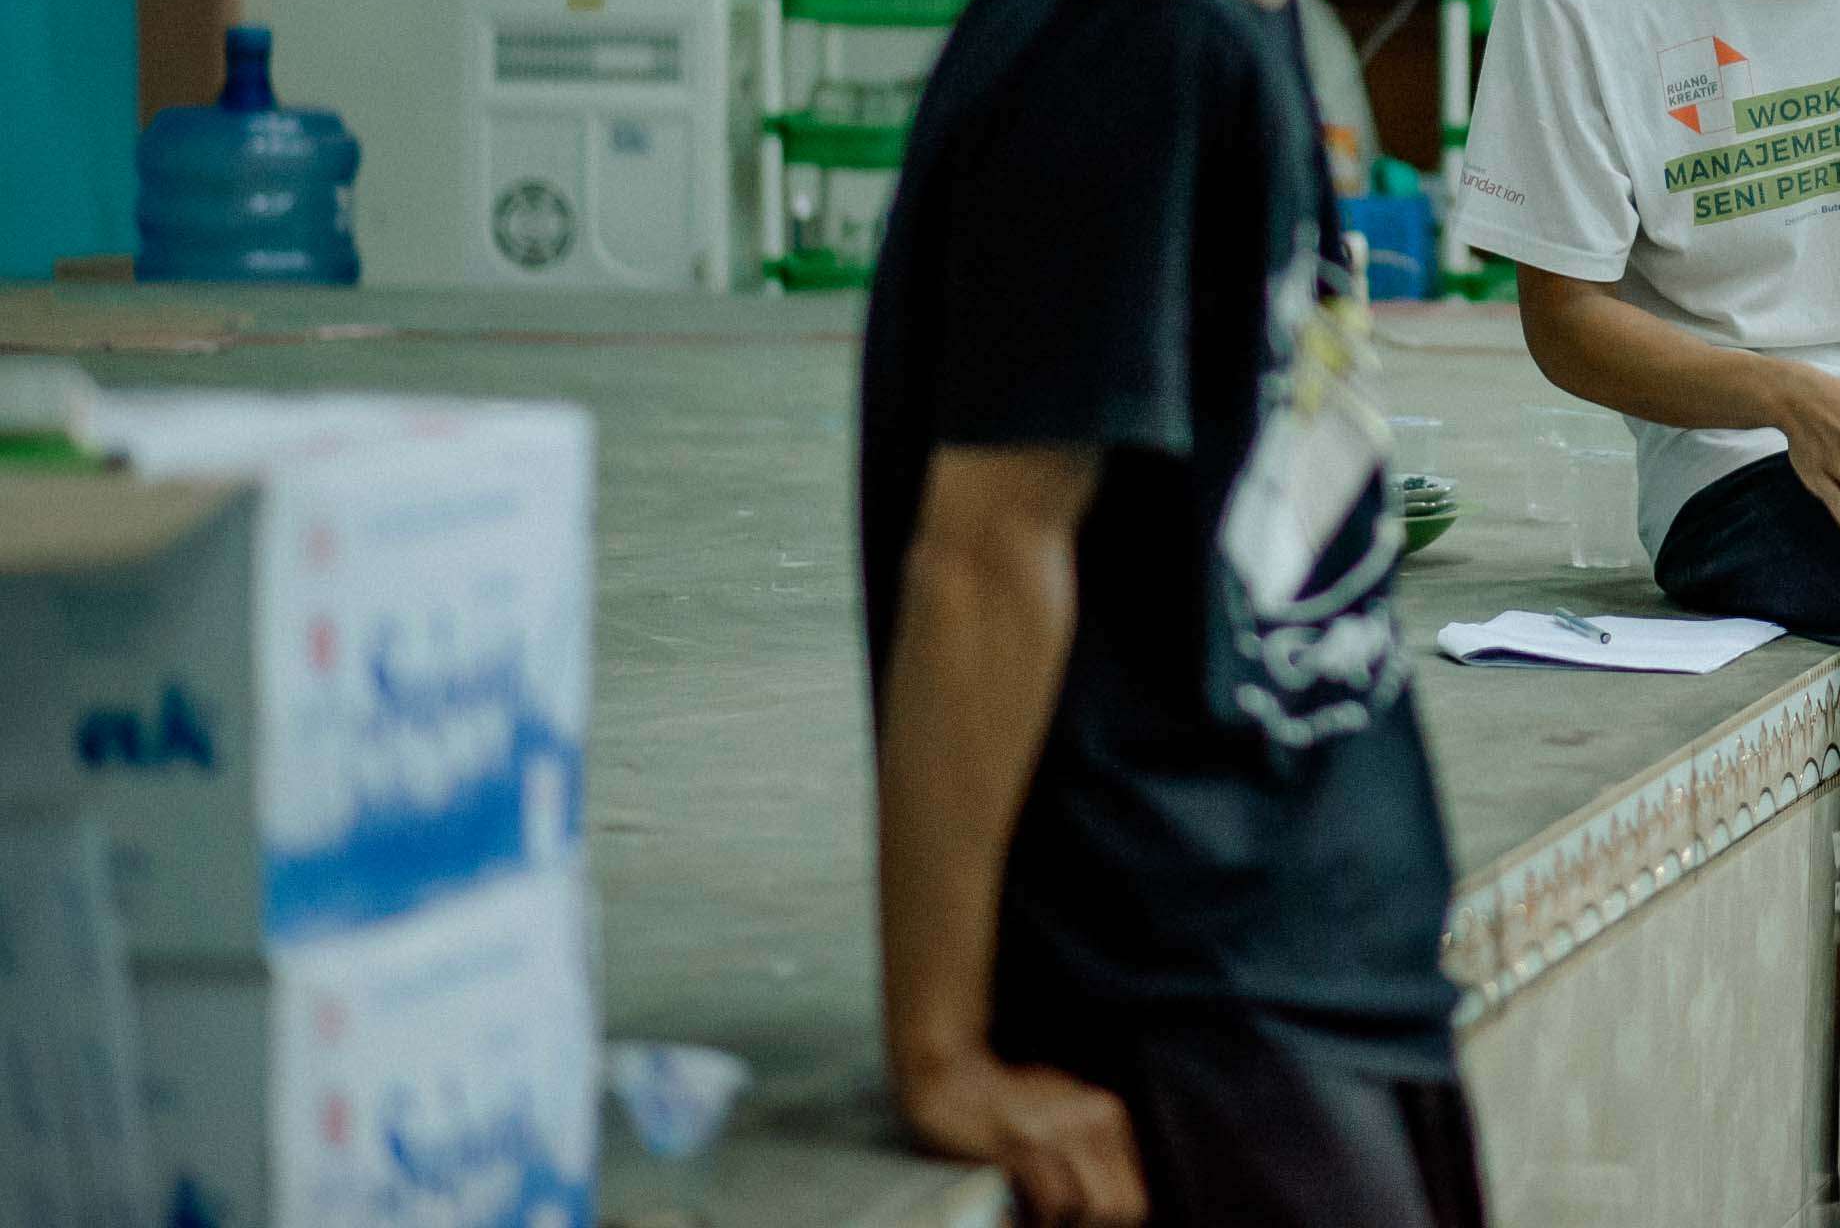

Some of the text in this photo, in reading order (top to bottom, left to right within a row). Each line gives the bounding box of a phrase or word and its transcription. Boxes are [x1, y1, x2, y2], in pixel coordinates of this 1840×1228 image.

[1666, 74, 1708, 95] RUANG
[1668, 83, 1718, 107] KREATIF
[1695, 183, 1766, 219] SENI
